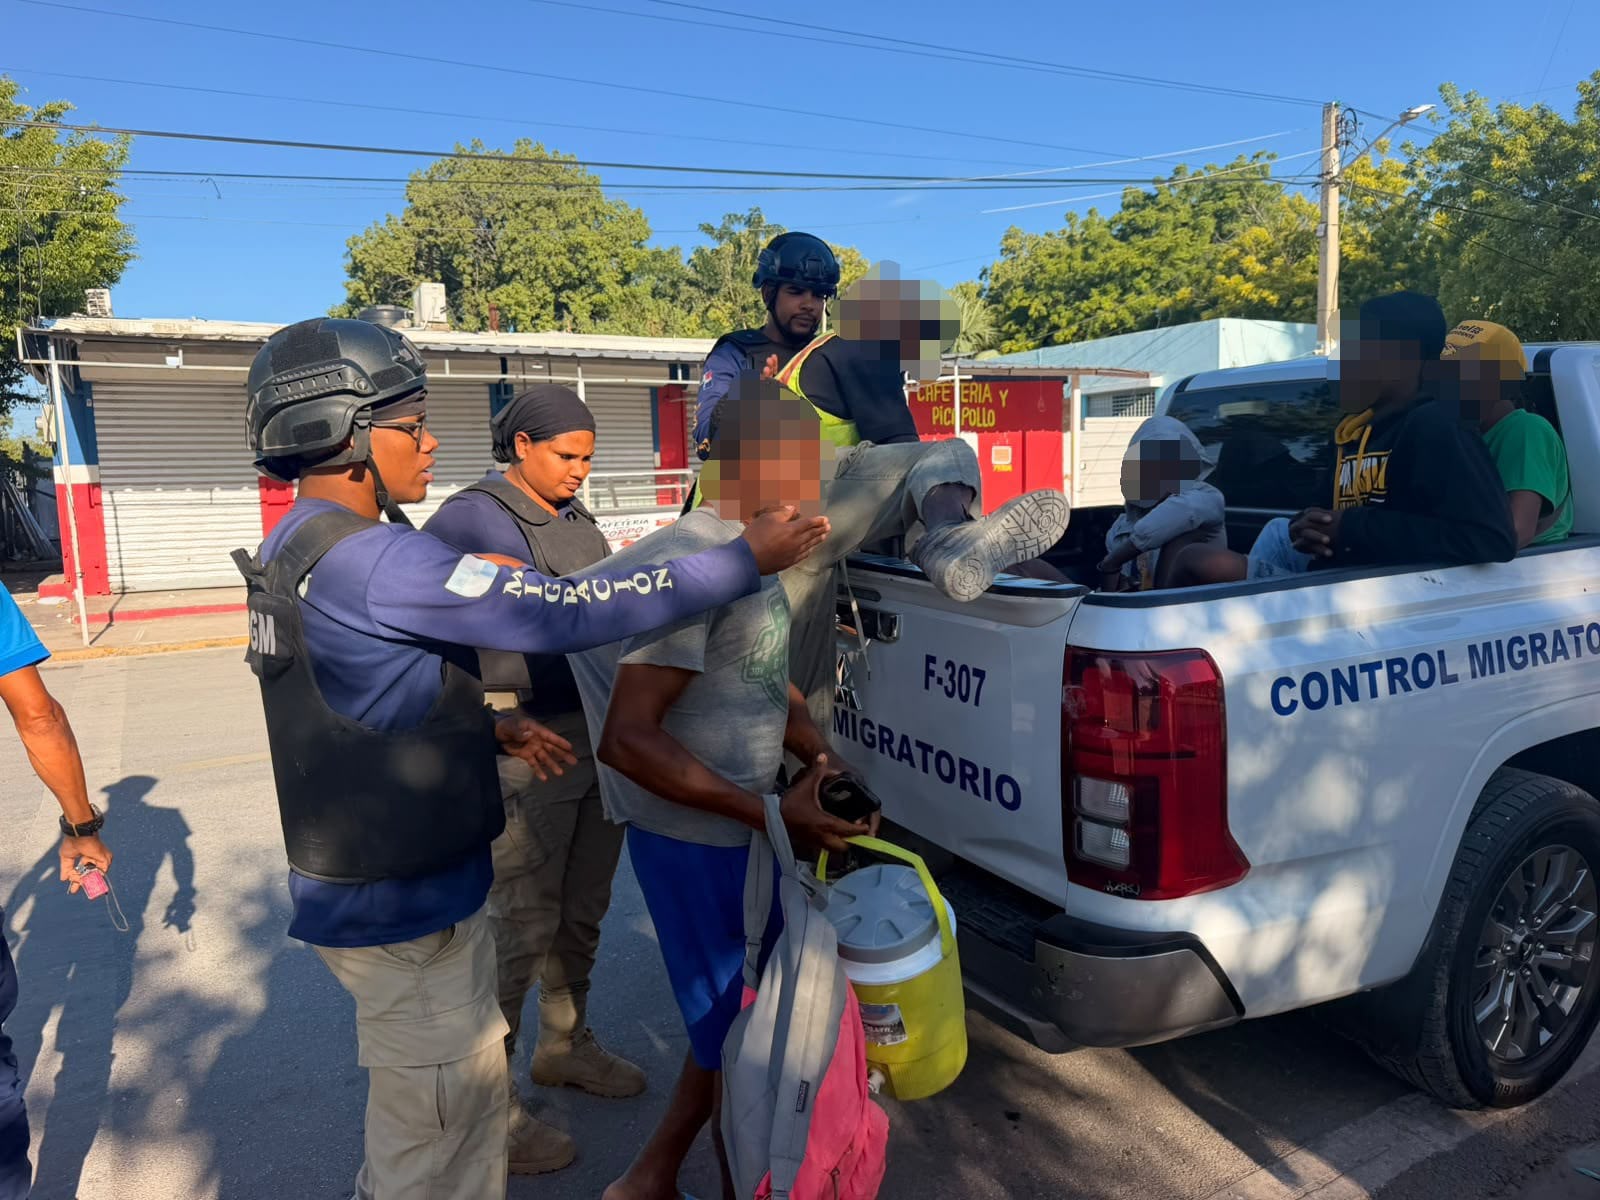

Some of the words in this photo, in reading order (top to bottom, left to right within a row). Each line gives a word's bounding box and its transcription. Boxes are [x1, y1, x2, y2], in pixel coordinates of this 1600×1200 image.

[917, 382, 993, 403] CAFEERIA
[998, 388, 1009, 408] Y
[924, 654, 987, 707] F-307
[1270, 650, 1459, 716] CONTROL
[1467, 622, 1600, 680] MIGRATO
[833, 705, 1022, 811] MIGRATORIO
